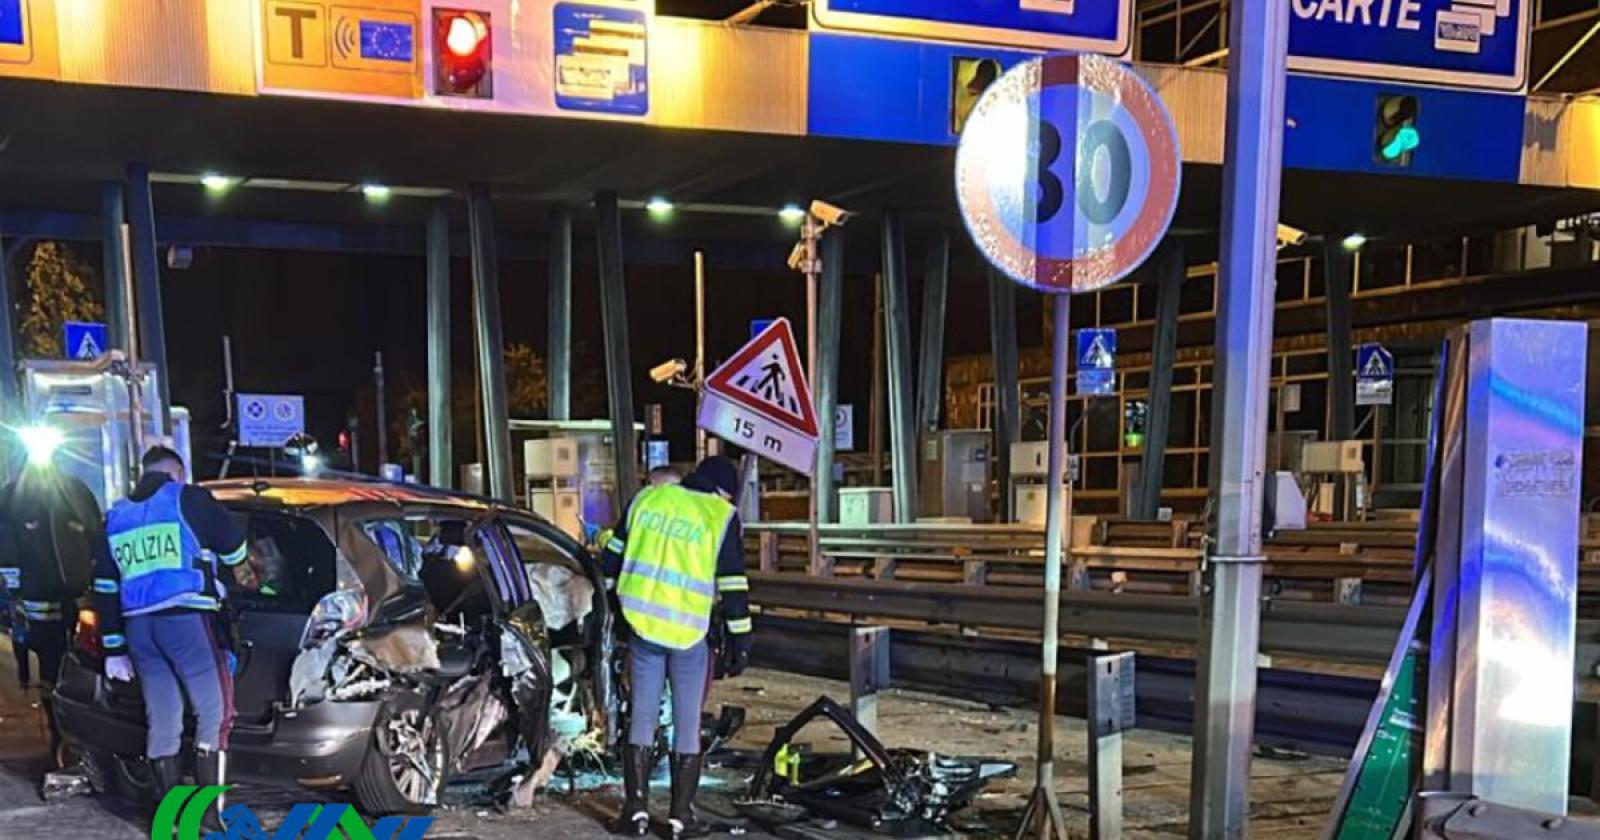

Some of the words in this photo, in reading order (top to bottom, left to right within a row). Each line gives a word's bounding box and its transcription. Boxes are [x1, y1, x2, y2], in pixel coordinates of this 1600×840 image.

[275, 8, 317, 58] T
[734, 418, 755, 439] 15
[763, 434, 783, 453] m
[114, 533, 179, 566] POLIZIA
